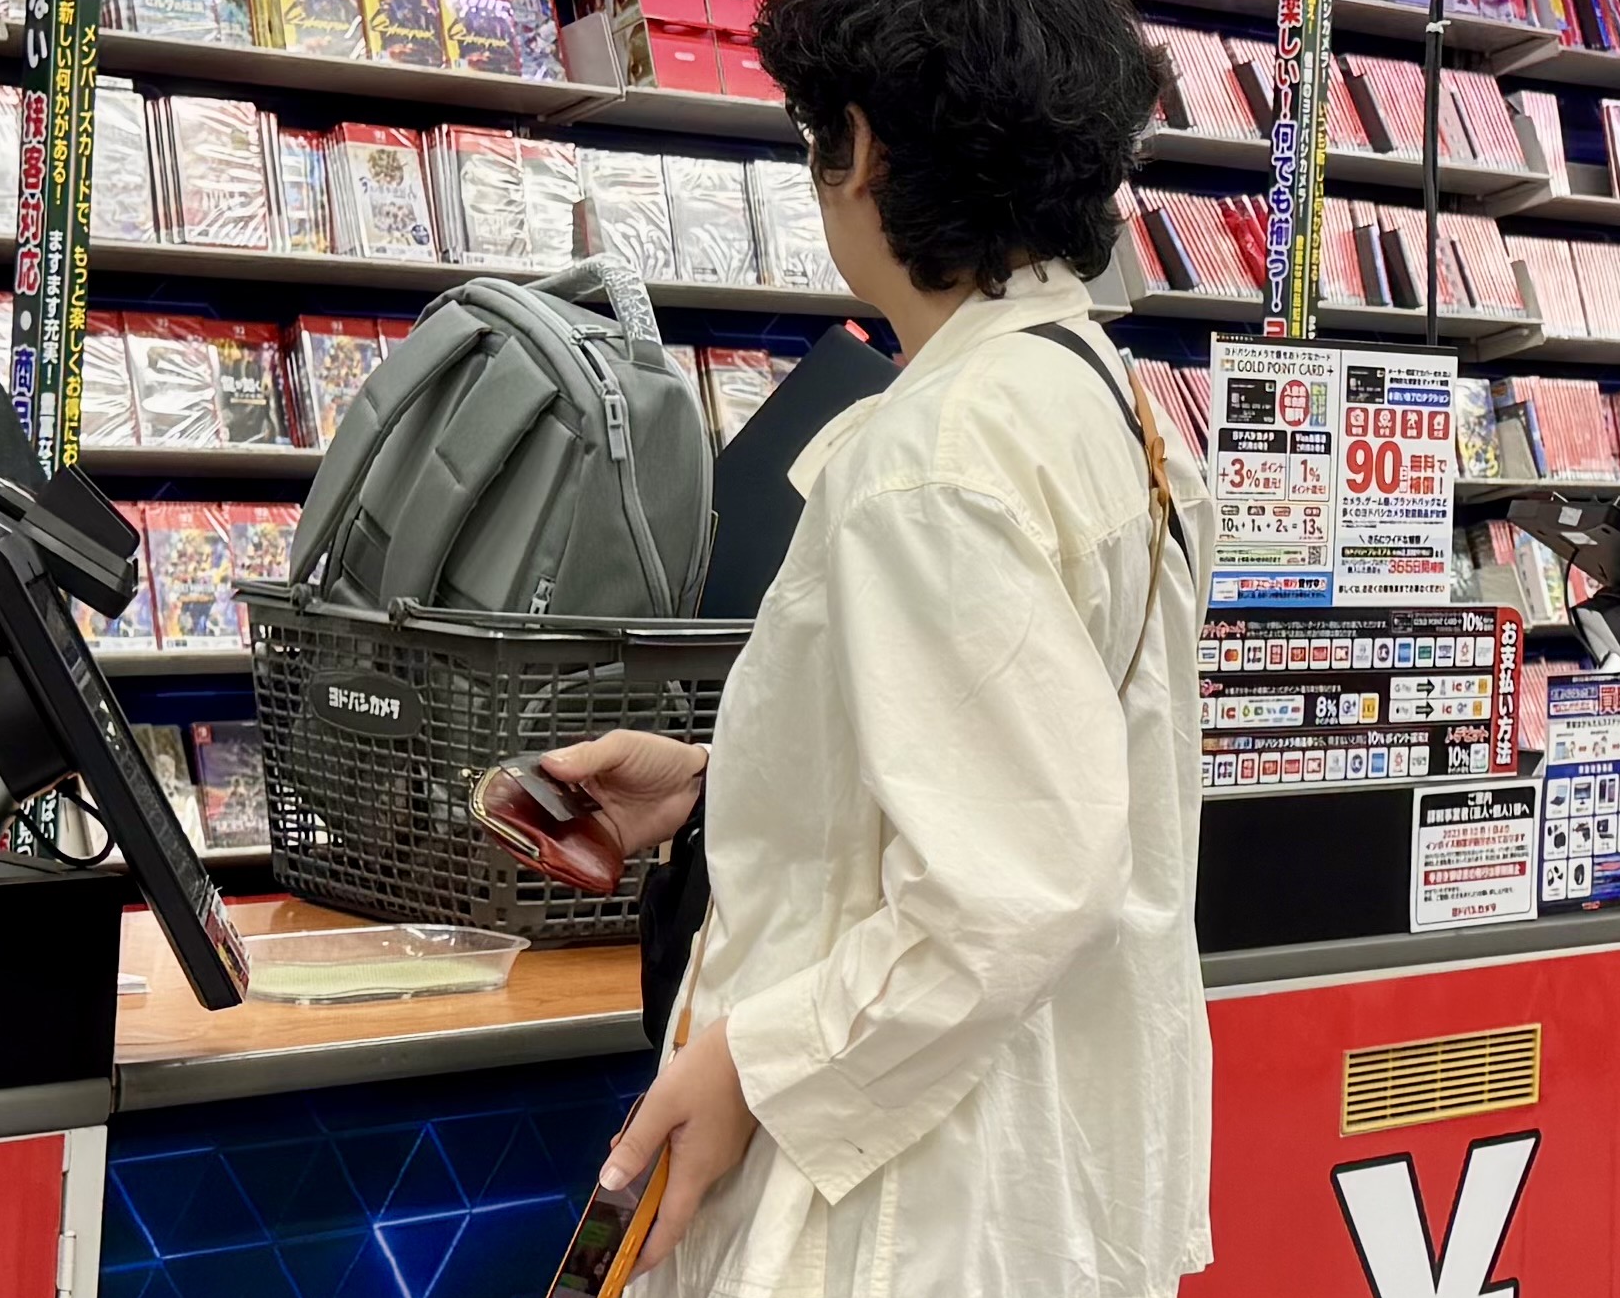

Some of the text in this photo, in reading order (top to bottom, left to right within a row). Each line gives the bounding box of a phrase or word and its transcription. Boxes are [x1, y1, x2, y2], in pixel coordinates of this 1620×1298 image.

[328, 686, 401, 720] ヨドバシカメラ
